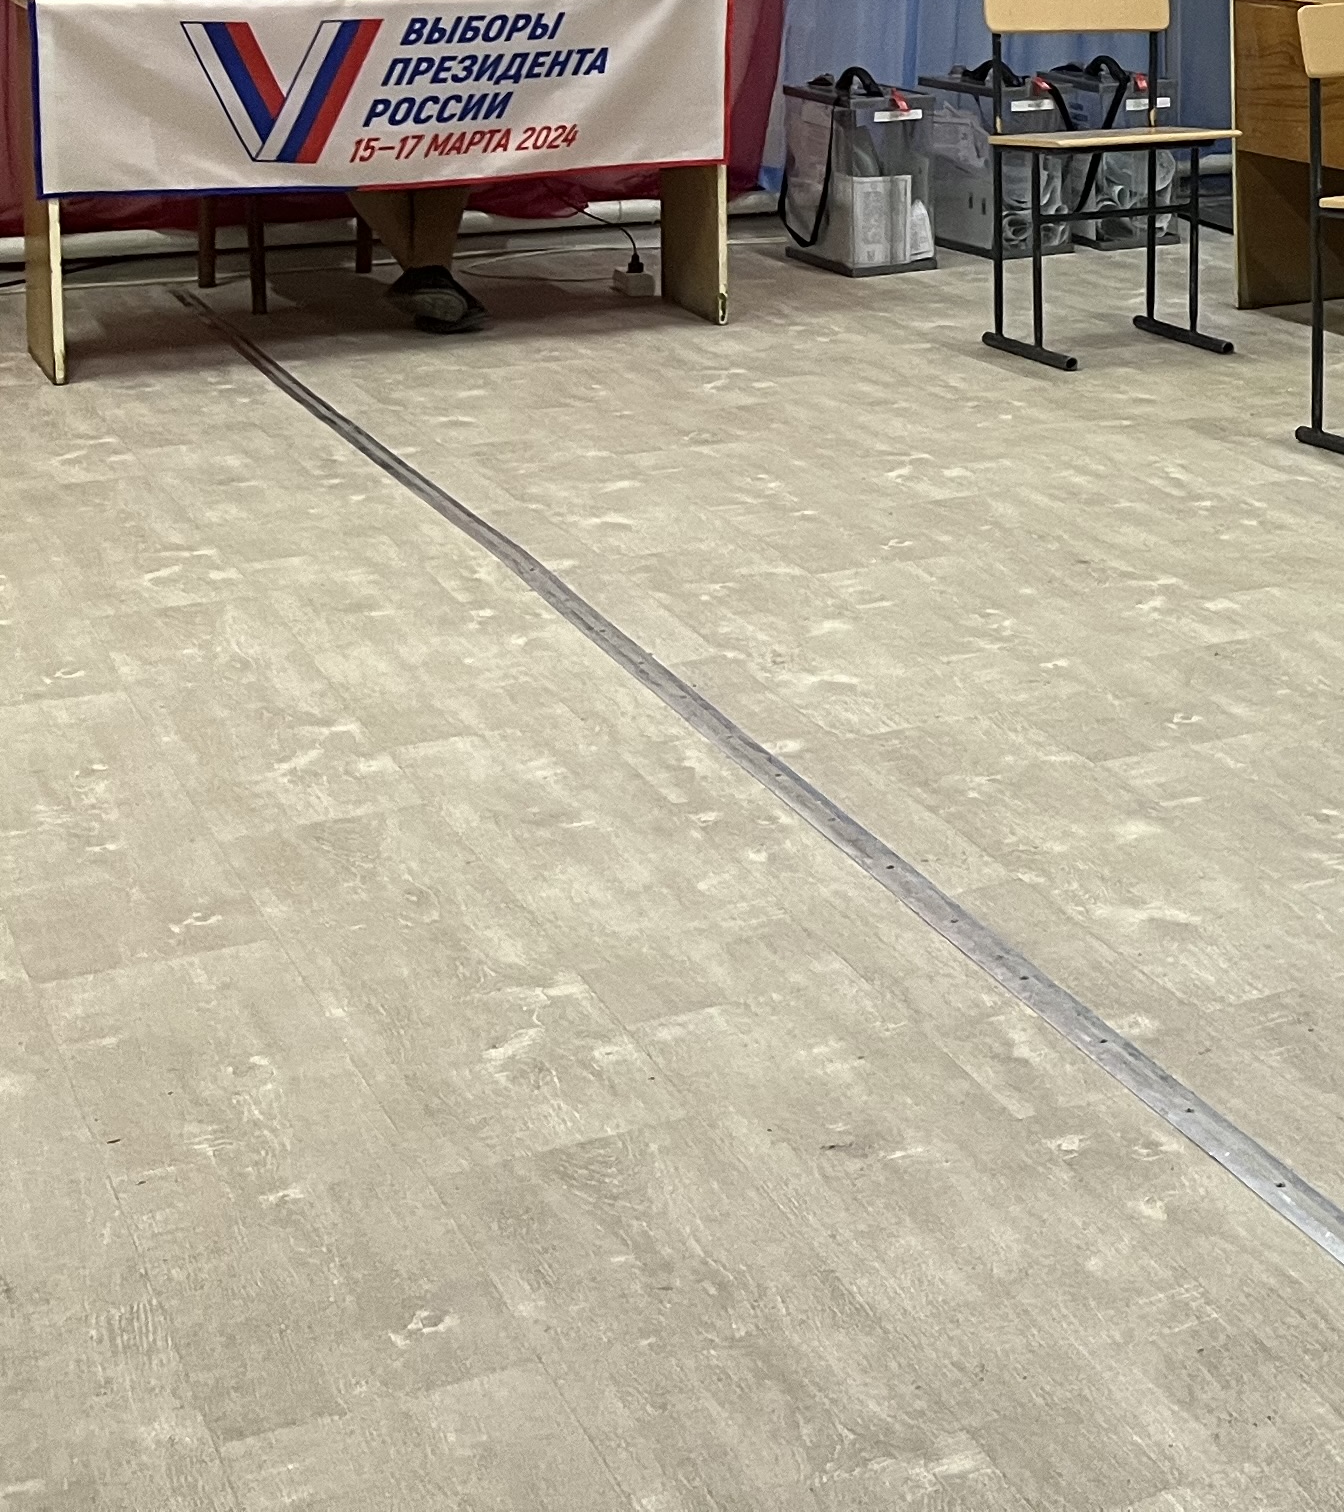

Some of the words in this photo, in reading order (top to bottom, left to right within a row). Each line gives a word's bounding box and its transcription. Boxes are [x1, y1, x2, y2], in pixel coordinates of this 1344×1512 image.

[400, 12, 566, 46] ВЫБОРЫ
[381, 47, 609, 87] ПРЕЗИДЕНТА
[362, 91, 514, 128] РОССИИ
[424, 128, 512, 159] МАРТА
[515, 124, 580, 152] 2024
